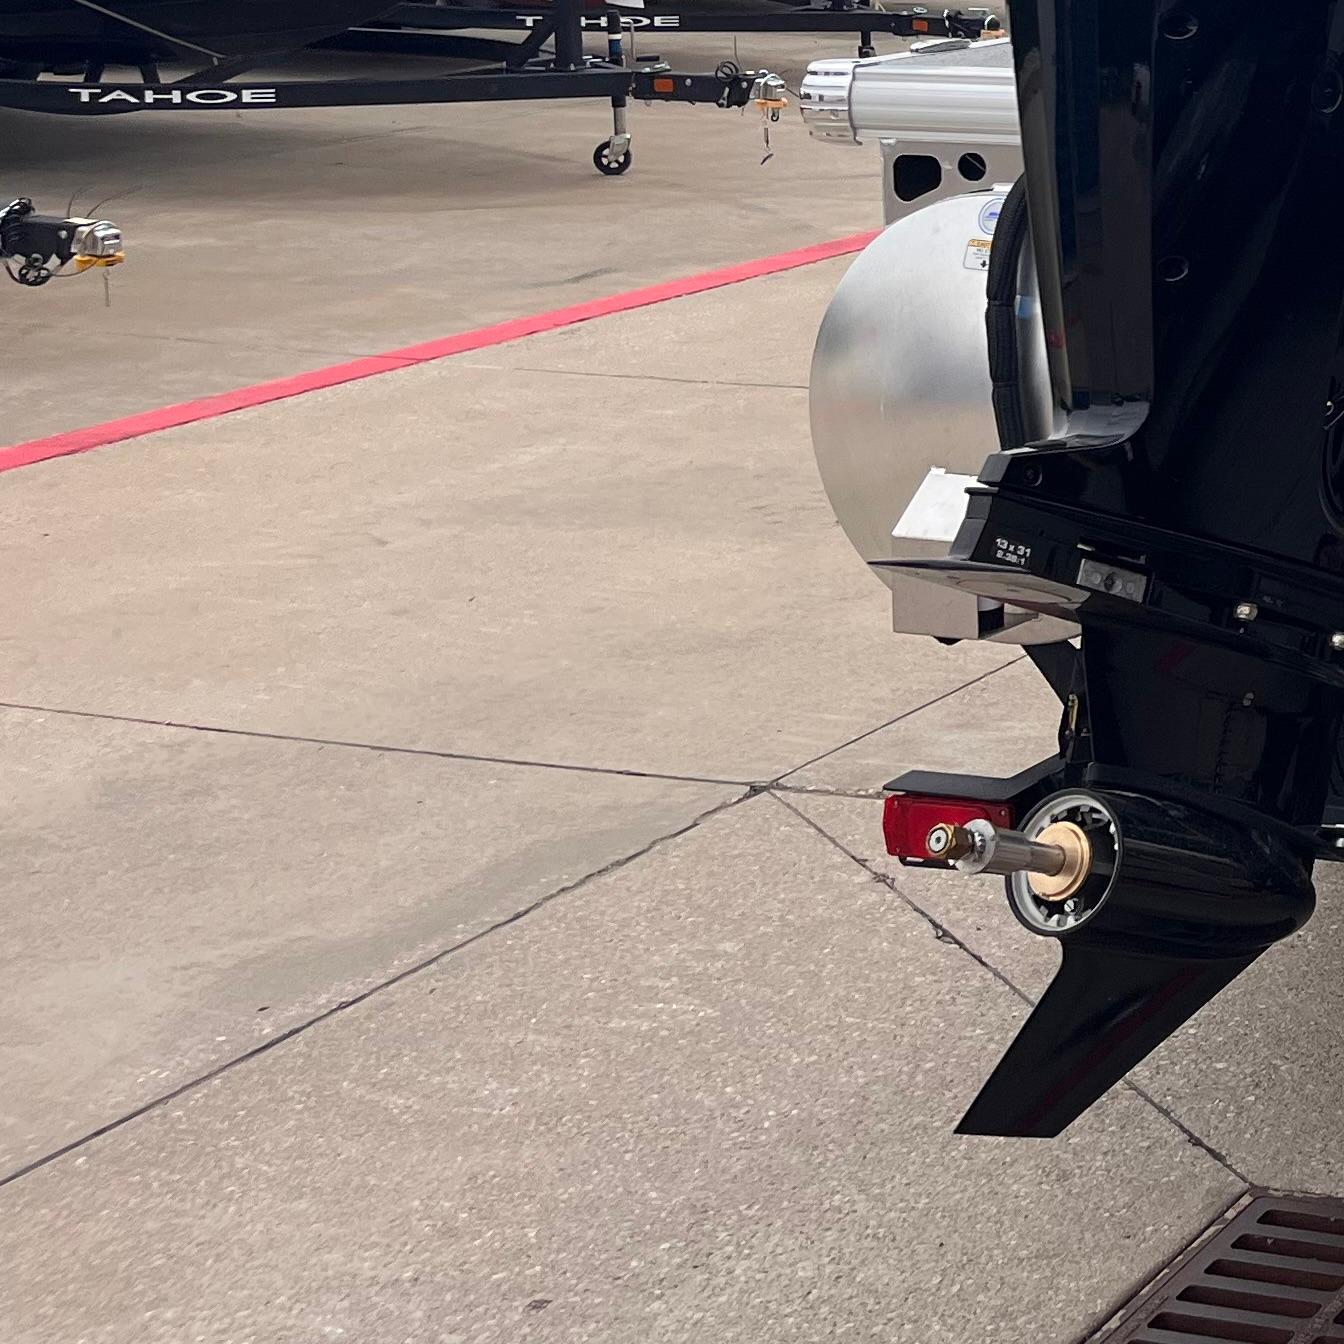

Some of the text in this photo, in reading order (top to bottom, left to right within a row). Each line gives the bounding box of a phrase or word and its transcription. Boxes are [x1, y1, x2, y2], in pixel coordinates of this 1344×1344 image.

[515, 15, 680, 27] THOE
[68, 88, 277, 104] TAHOE
[995, 538, 1009, 550] 13
[1016, 545, 1032, 558] 31
